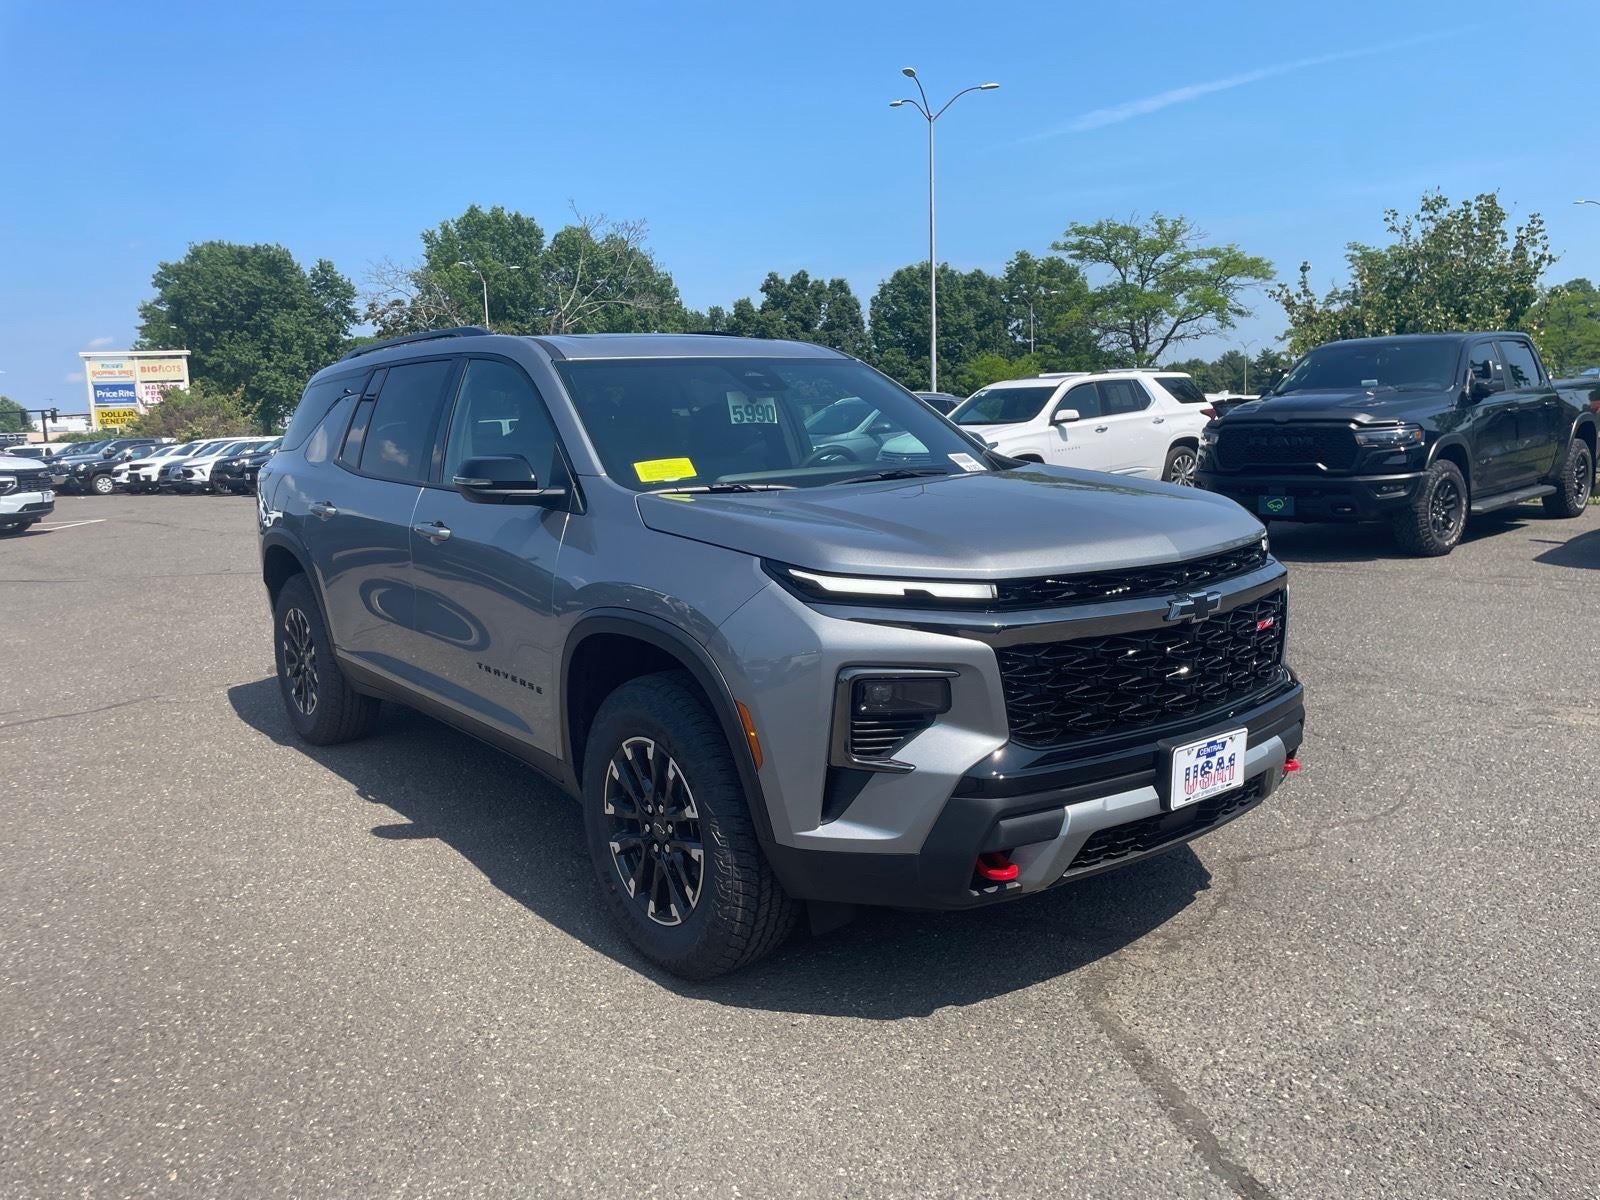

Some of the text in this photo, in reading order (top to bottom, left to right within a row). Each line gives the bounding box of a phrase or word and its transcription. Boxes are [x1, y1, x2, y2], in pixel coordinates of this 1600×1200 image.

[96, 390, 118, 398] Price
[118, 389, 135, 398] Rite
[732, 404, 776, 423] 5990
[477, 662, 543, 695] TRAVERSE
[1200, 744, 1224, 755] CENTRAL
